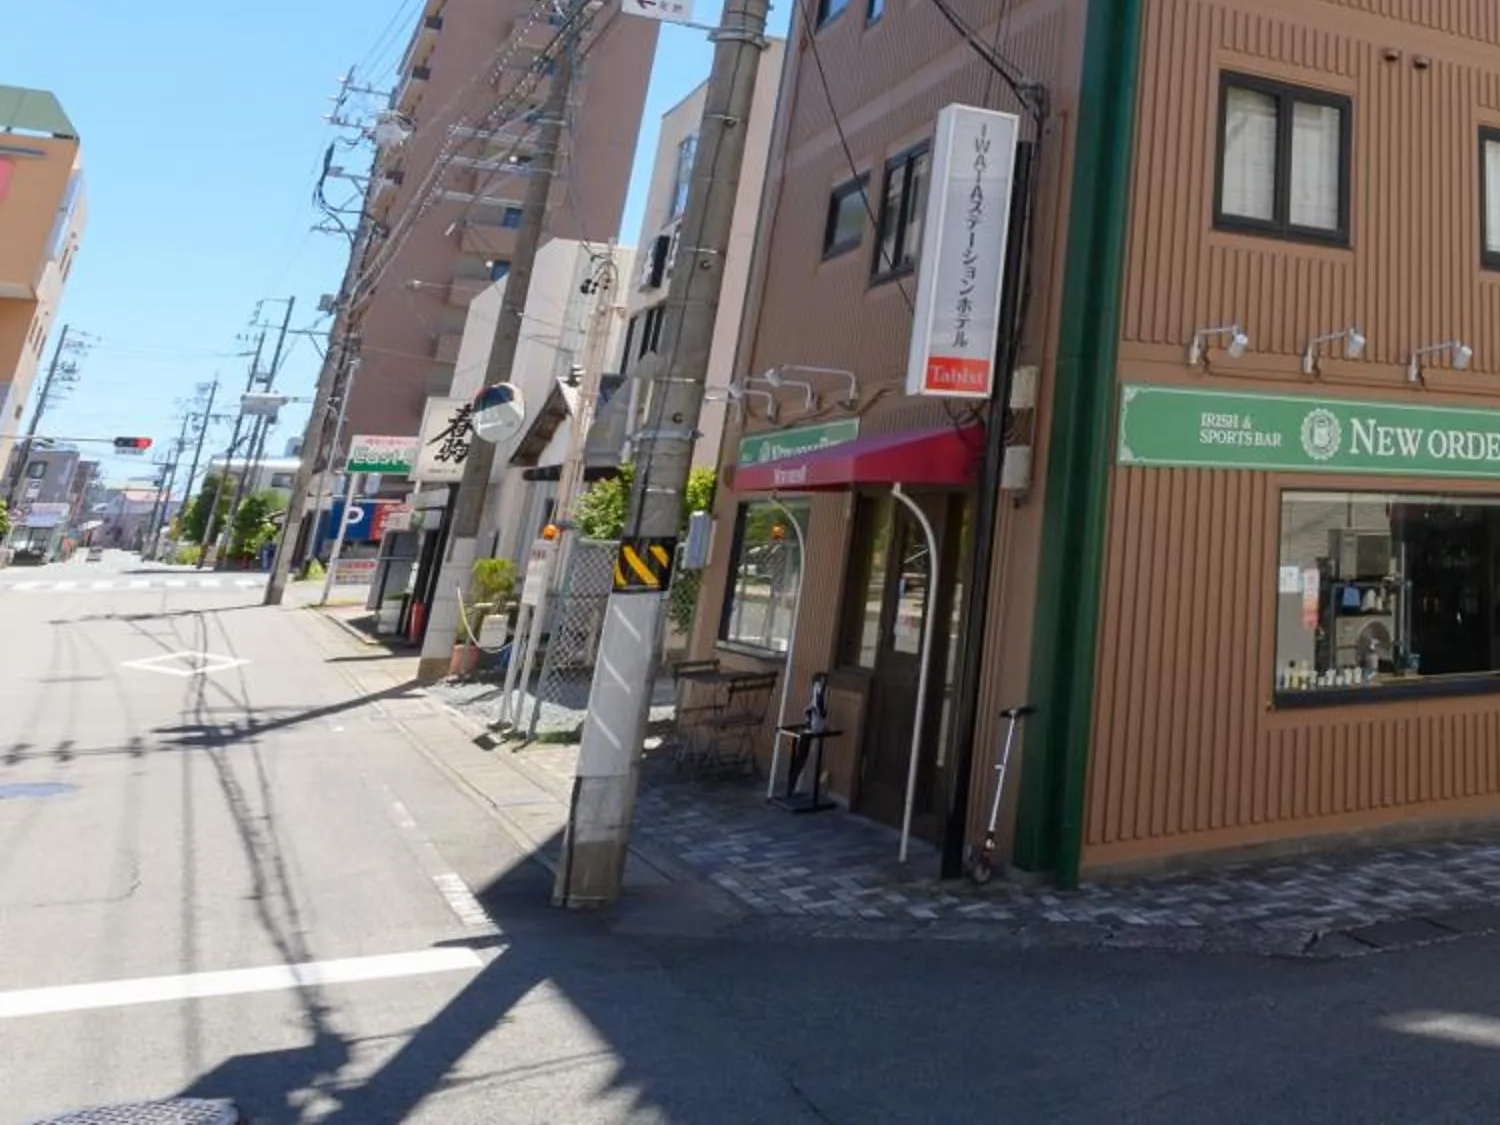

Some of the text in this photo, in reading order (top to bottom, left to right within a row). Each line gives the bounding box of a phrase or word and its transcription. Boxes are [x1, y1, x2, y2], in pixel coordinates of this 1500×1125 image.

[1201, 412, 1239, 428] IRISH
[1199, 429, 1282, 447] SPORTS BAR
[1350, 417, 1423, 457] NEW
